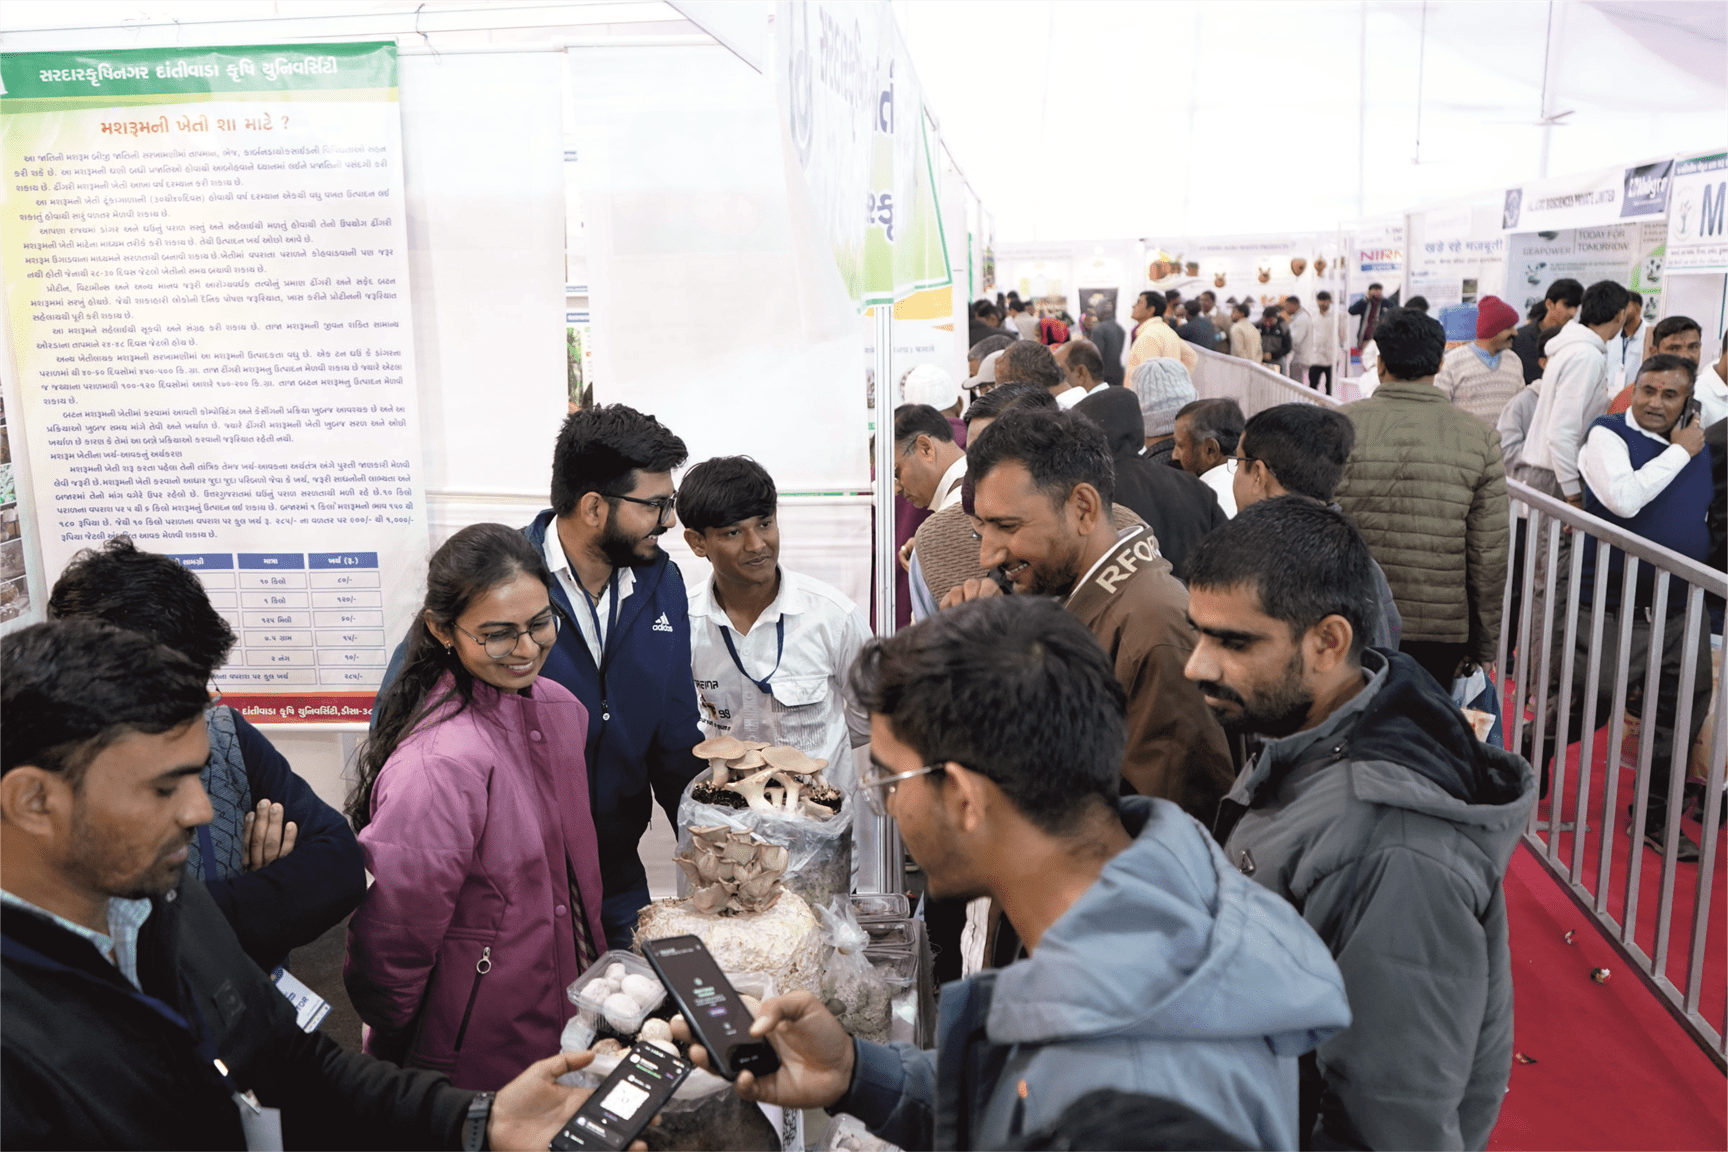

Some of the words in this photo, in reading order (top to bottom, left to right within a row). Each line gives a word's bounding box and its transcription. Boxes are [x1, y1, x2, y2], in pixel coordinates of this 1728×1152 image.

[40, 63, 149, 86] સરદારકૃષિનગર
[157, 61, 219, 78] દાંતીવાડા
[226, 59, 254, 82] કૃષિ
[100, 116, 169, 137] મશરૂમની
[176, 114, 209, 132] ખેતી
[217, 119, 235, 131] શા
[245, 112, 273, 131] માટે
[281, 115, 289, 130] ?
[652, 623, 673, 632] adidas
[242, 705, 277, 716] દાંતીવાડા
[279, 705, 295, 719] કૃષિ
